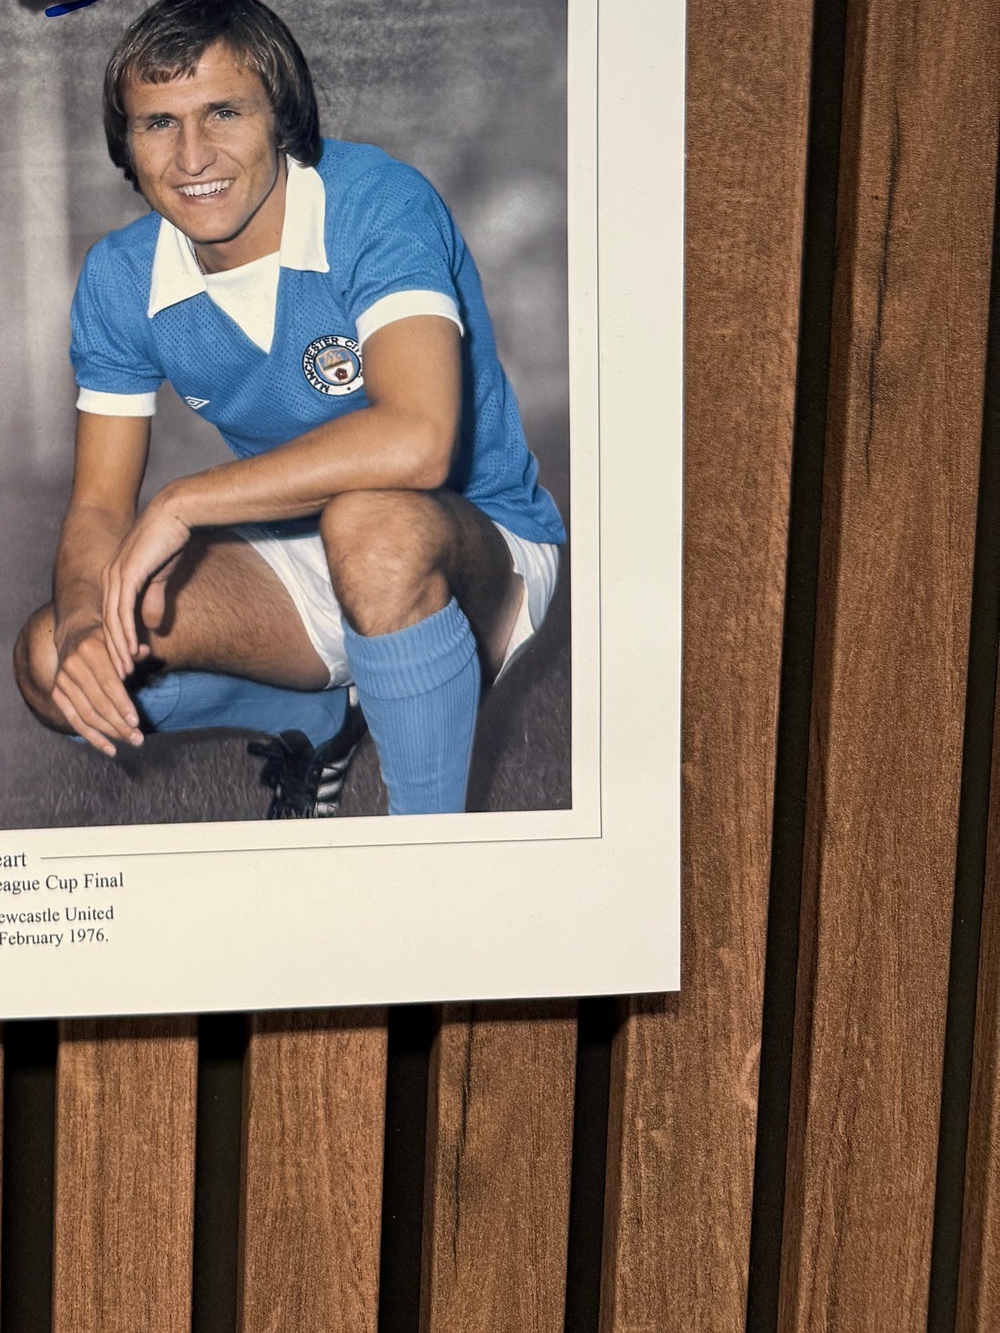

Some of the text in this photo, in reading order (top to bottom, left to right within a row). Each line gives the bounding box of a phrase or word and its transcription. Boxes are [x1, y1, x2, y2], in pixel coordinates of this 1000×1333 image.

[304, 336, 340, 394] MANCHESTER
[45, 874, 79, 894] Cup
[84, 871, 124, 889] Final
[65, 905, 114, 922] United
[70, 927, 110, 943] 1976.
